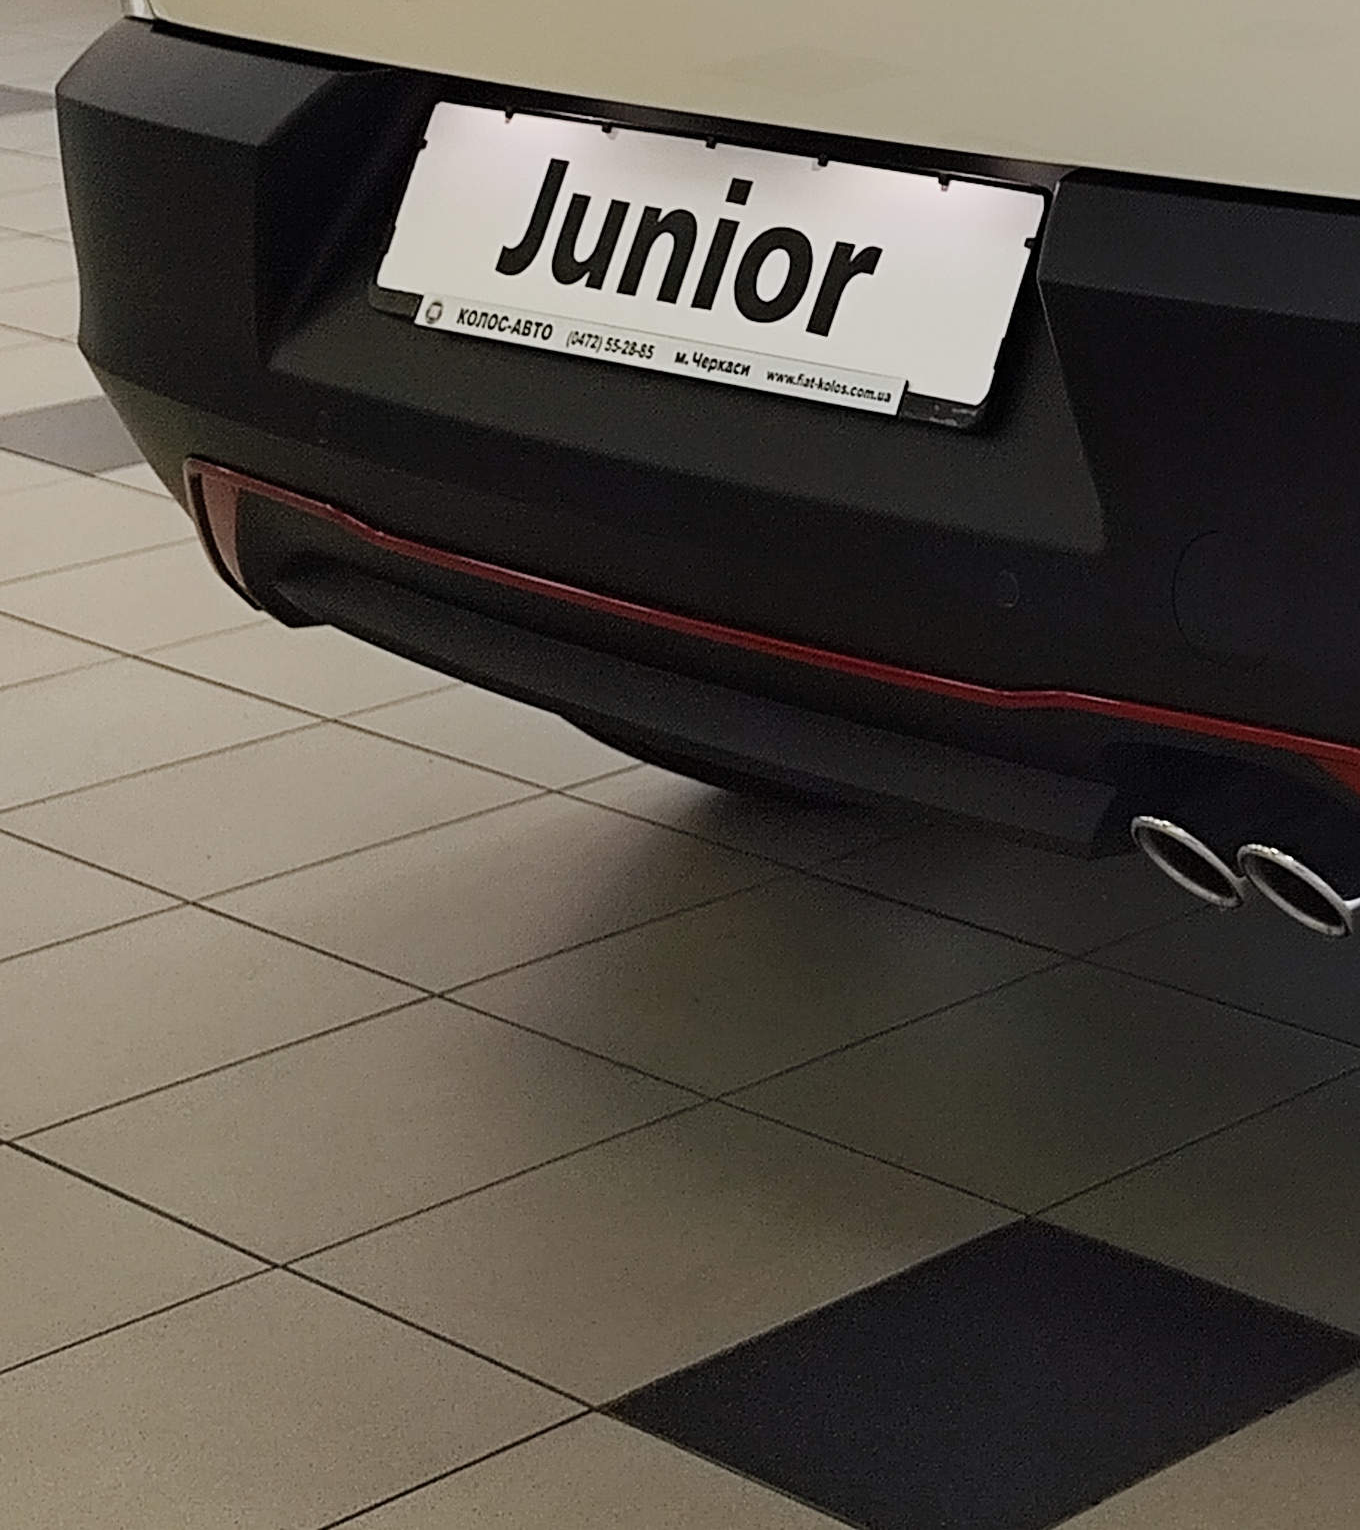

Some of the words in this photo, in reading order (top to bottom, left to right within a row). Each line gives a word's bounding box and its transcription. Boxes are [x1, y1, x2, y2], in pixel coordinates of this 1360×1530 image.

[494, 158, 884, 338] Junior
[456, 306, 554, 341] КОЛОС-АВТО
[566, 330, 603, 354] (0472)
[673, 351, 689, 366] м.
[692, 351, 752, 378] Черкаси
[765, 369, 893, 404] www.fiat-kolos.com.ua
